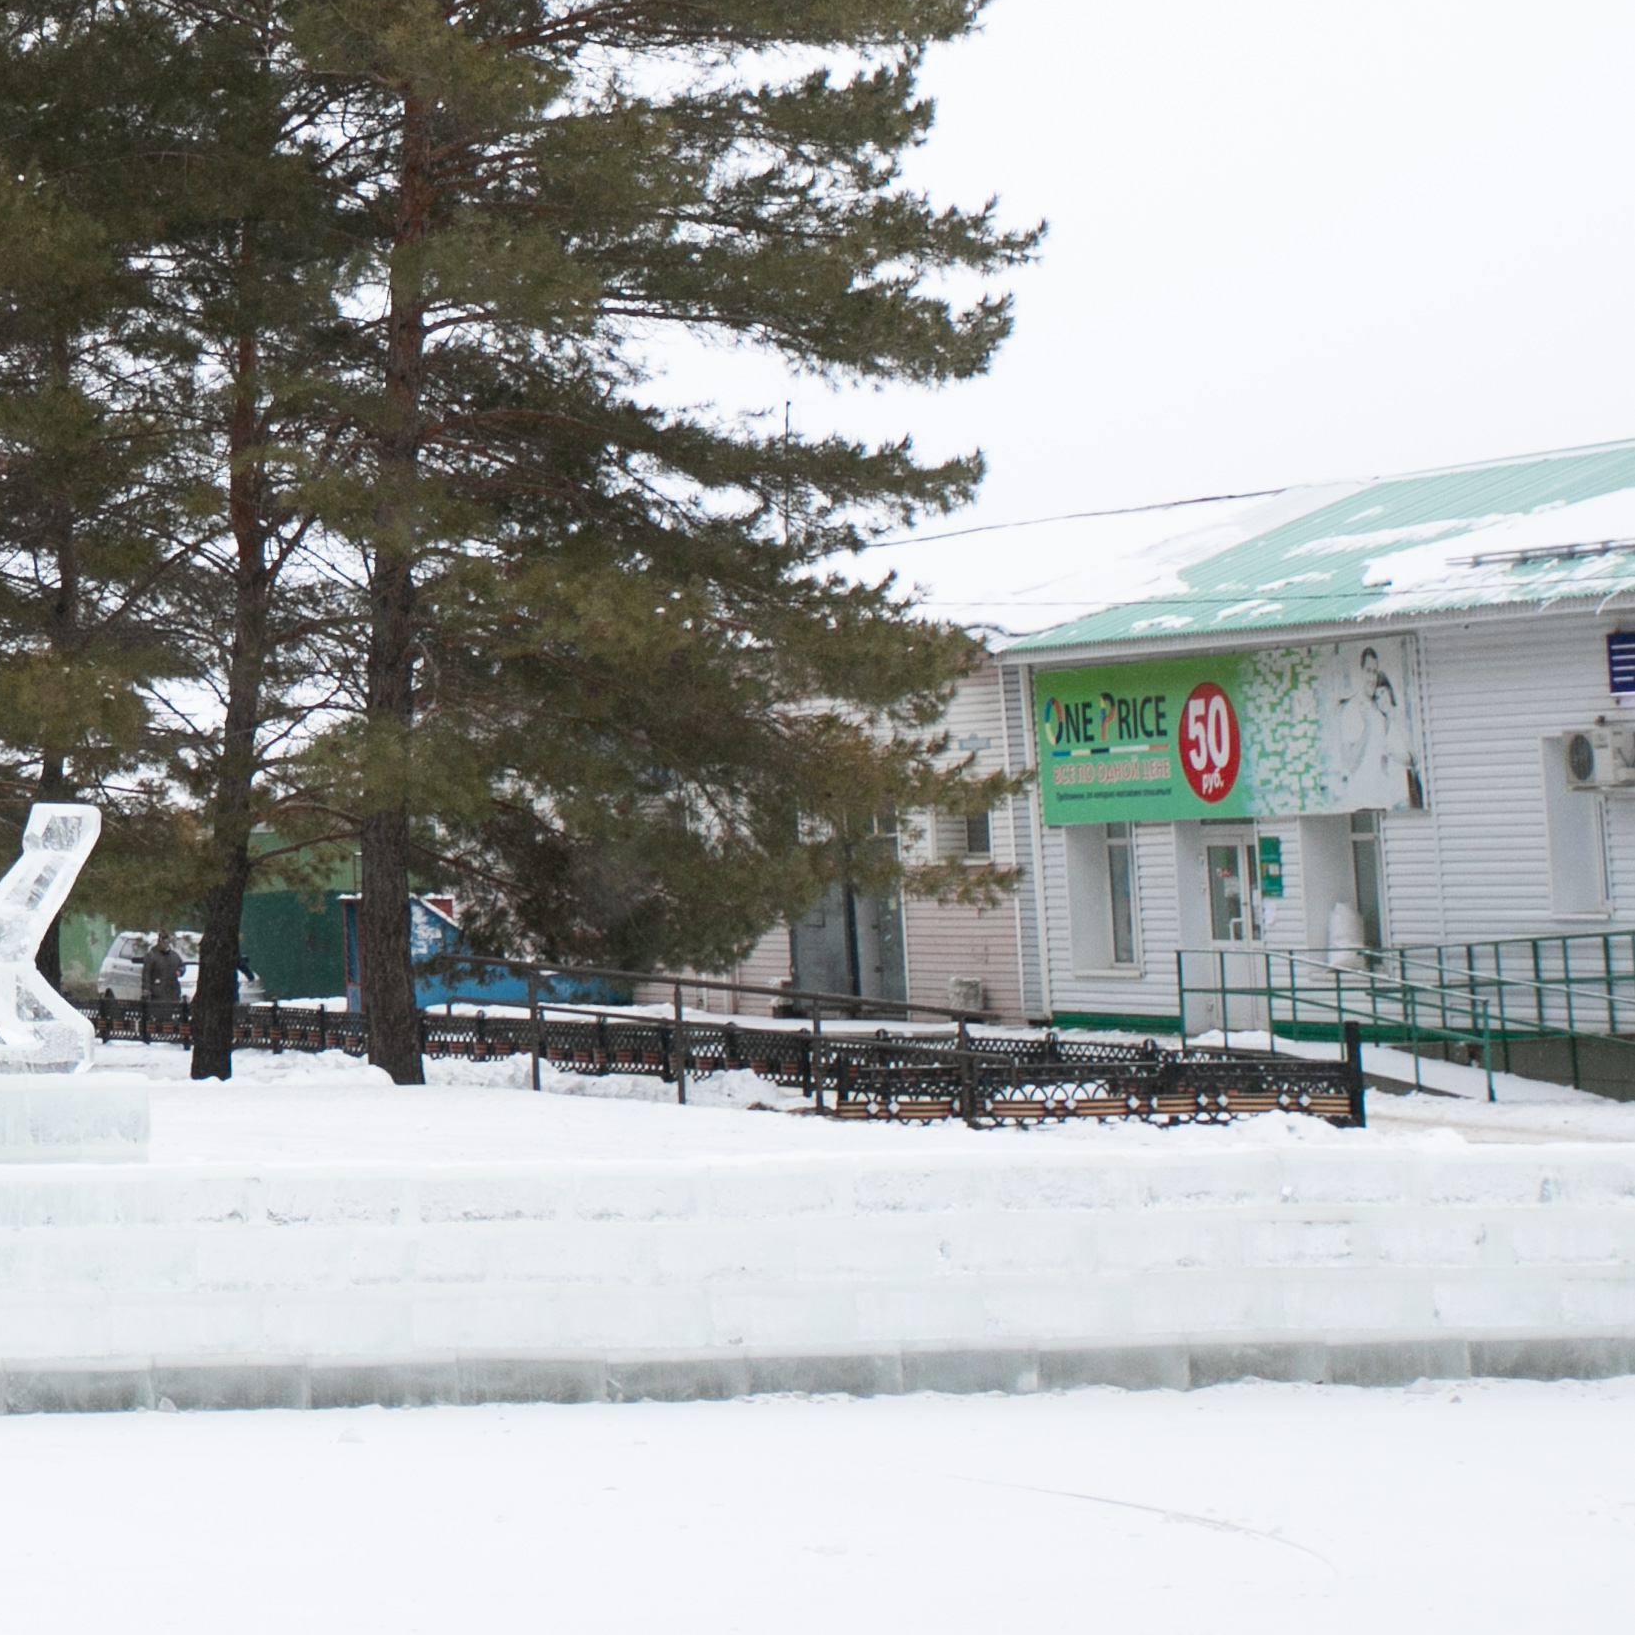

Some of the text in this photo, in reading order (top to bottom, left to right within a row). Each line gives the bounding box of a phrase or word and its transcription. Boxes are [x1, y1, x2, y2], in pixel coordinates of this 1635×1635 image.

[1044, 691, 1168, 745] ONE PRICE
[1187, 694, 1230, 771] 50
[1053, 754, 1172, 785] ВСЕ ПО ОДНОЙ ЦЕНЕ
[1202, 768, 1224, 795] руб.
